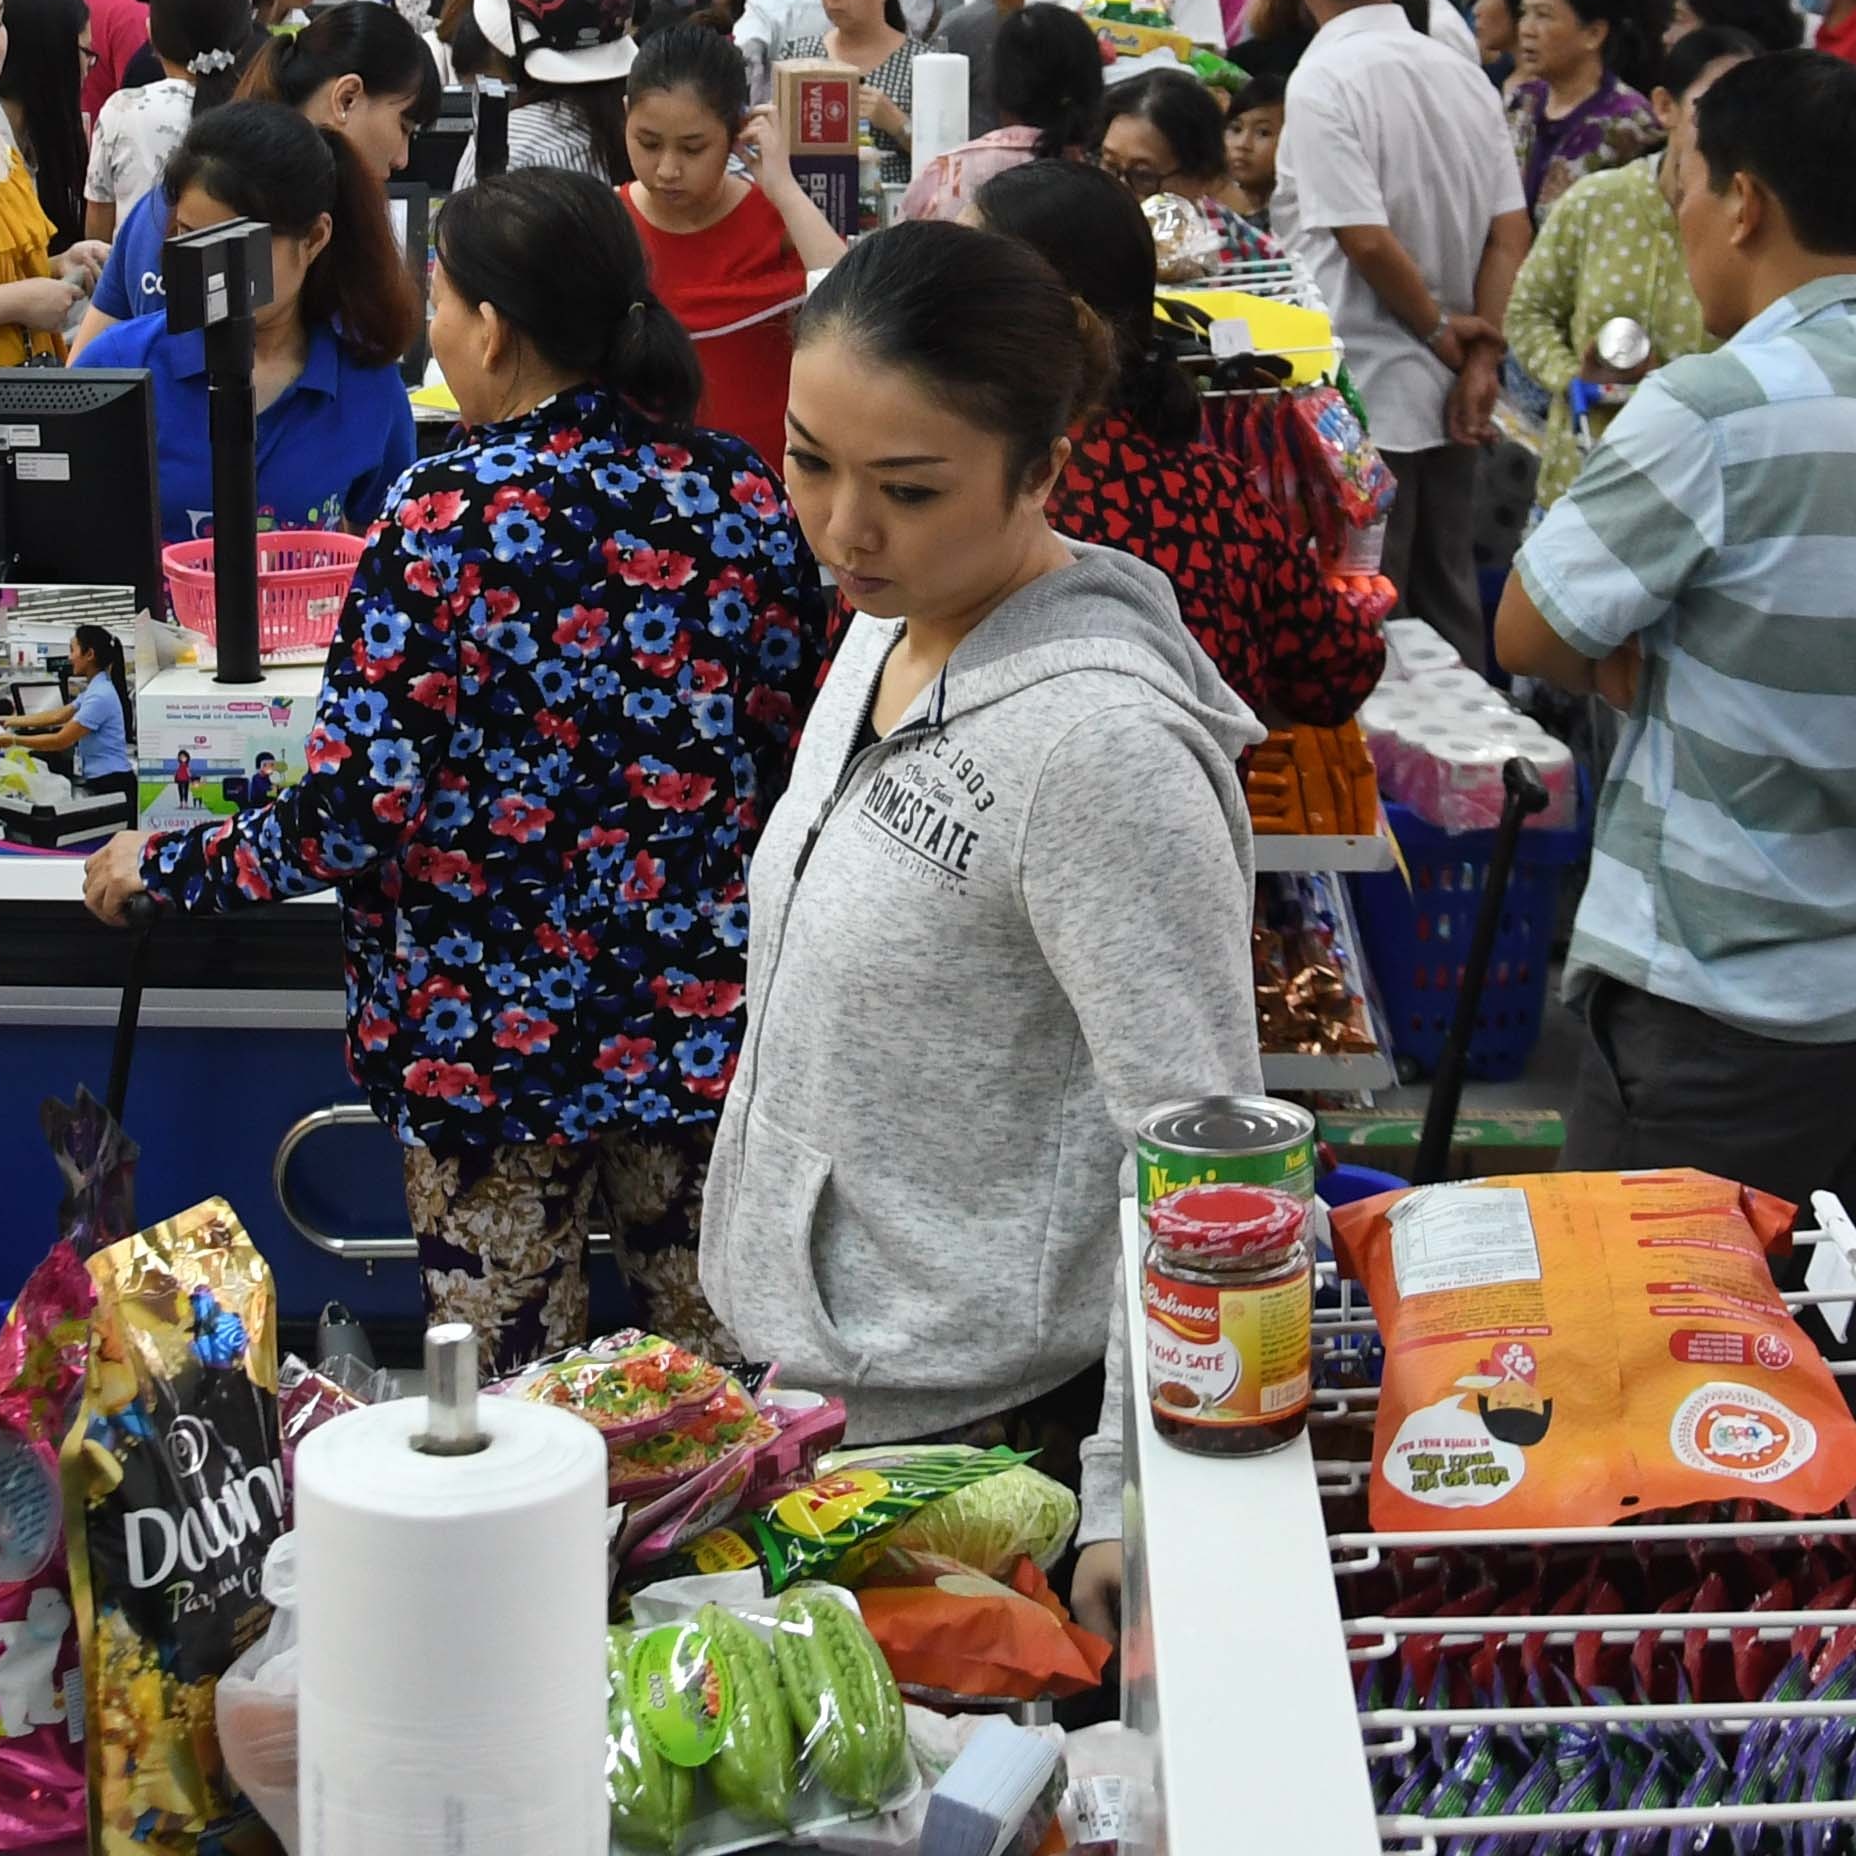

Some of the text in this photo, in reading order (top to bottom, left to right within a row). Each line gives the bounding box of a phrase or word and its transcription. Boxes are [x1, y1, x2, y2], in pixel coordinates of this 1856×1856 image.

[809, 85, 823, 139] VIFON
[948, 749, 996, 813] 1903
[864, 769, 980, 872] HOMESTATE
